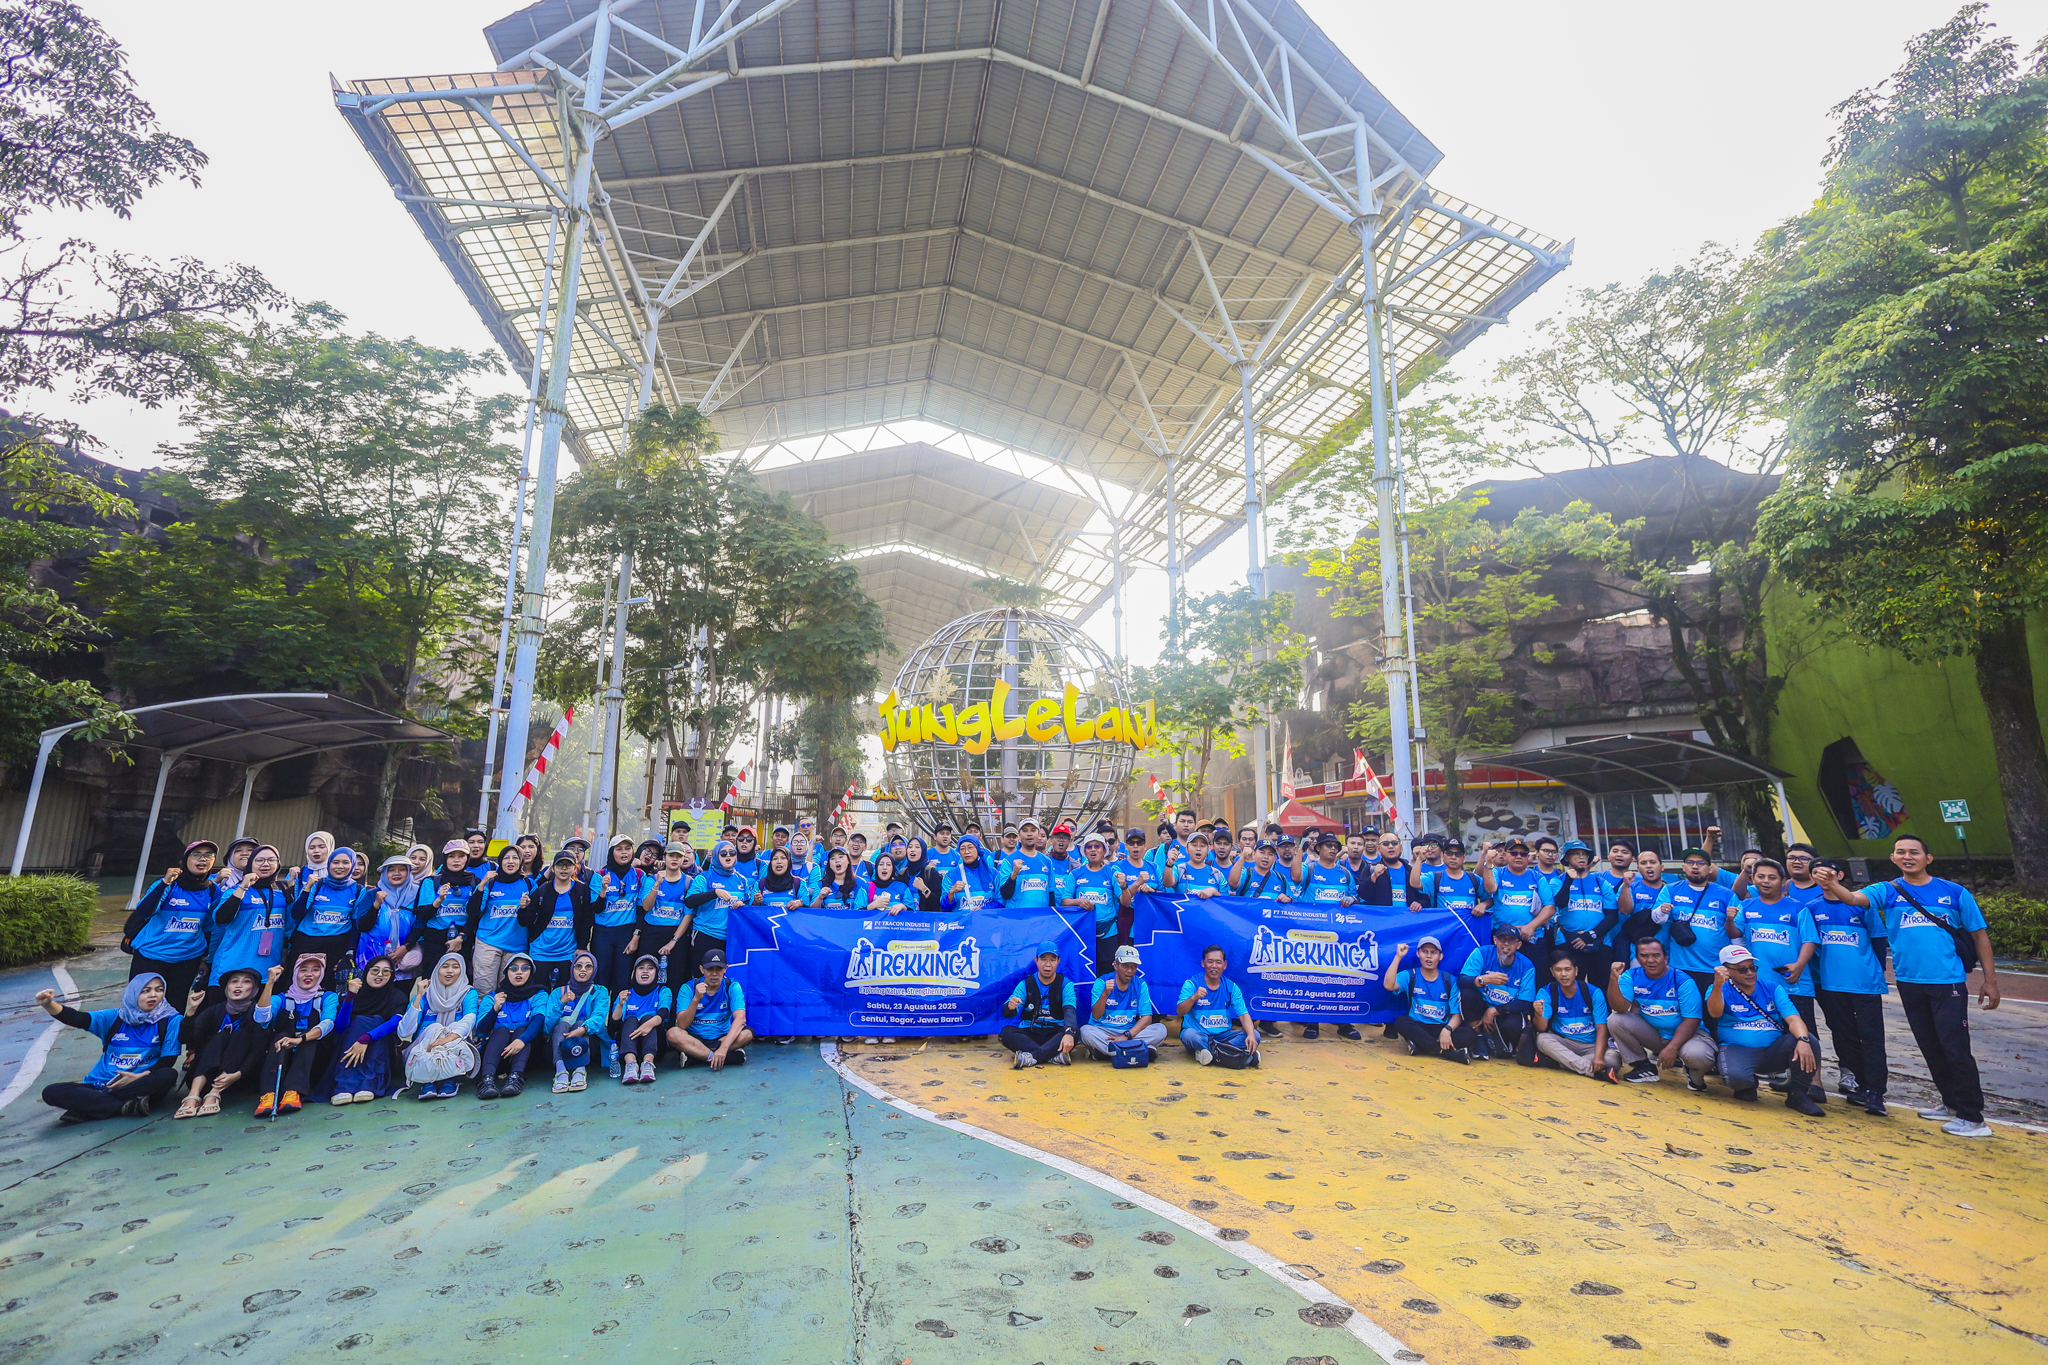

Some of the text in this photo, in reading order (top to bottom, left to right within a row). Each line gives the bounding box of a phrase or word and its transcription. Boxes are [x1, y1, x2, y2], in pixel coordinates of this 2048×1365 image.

[1957, 828, 1964, 837] 1
[1272, 938, 1361, 968] TREKKING
[872, 950, 963, 977] TREKKING
[859, 986, 886, 995] Exploring
[886, 987, 906, 996] Nature,
[906, 987, 947, 996] Strengthening
[1268, 988, 1293, 996] Sabtu,
[1304, 990, 1336, 999] Agustus
[1337, 991, 1355, 999] 2025
[866, 1002, 892, 1010] Sabtu,
[903, 1003, 937, 1012] Agustus
[1261, 1001, 1289, 1010] Sentul,
[1290, 1002, 1315, 1011] Bogor,
[860, 1015, 963, 1025] Sentul, Bogor, Jawa Barat
